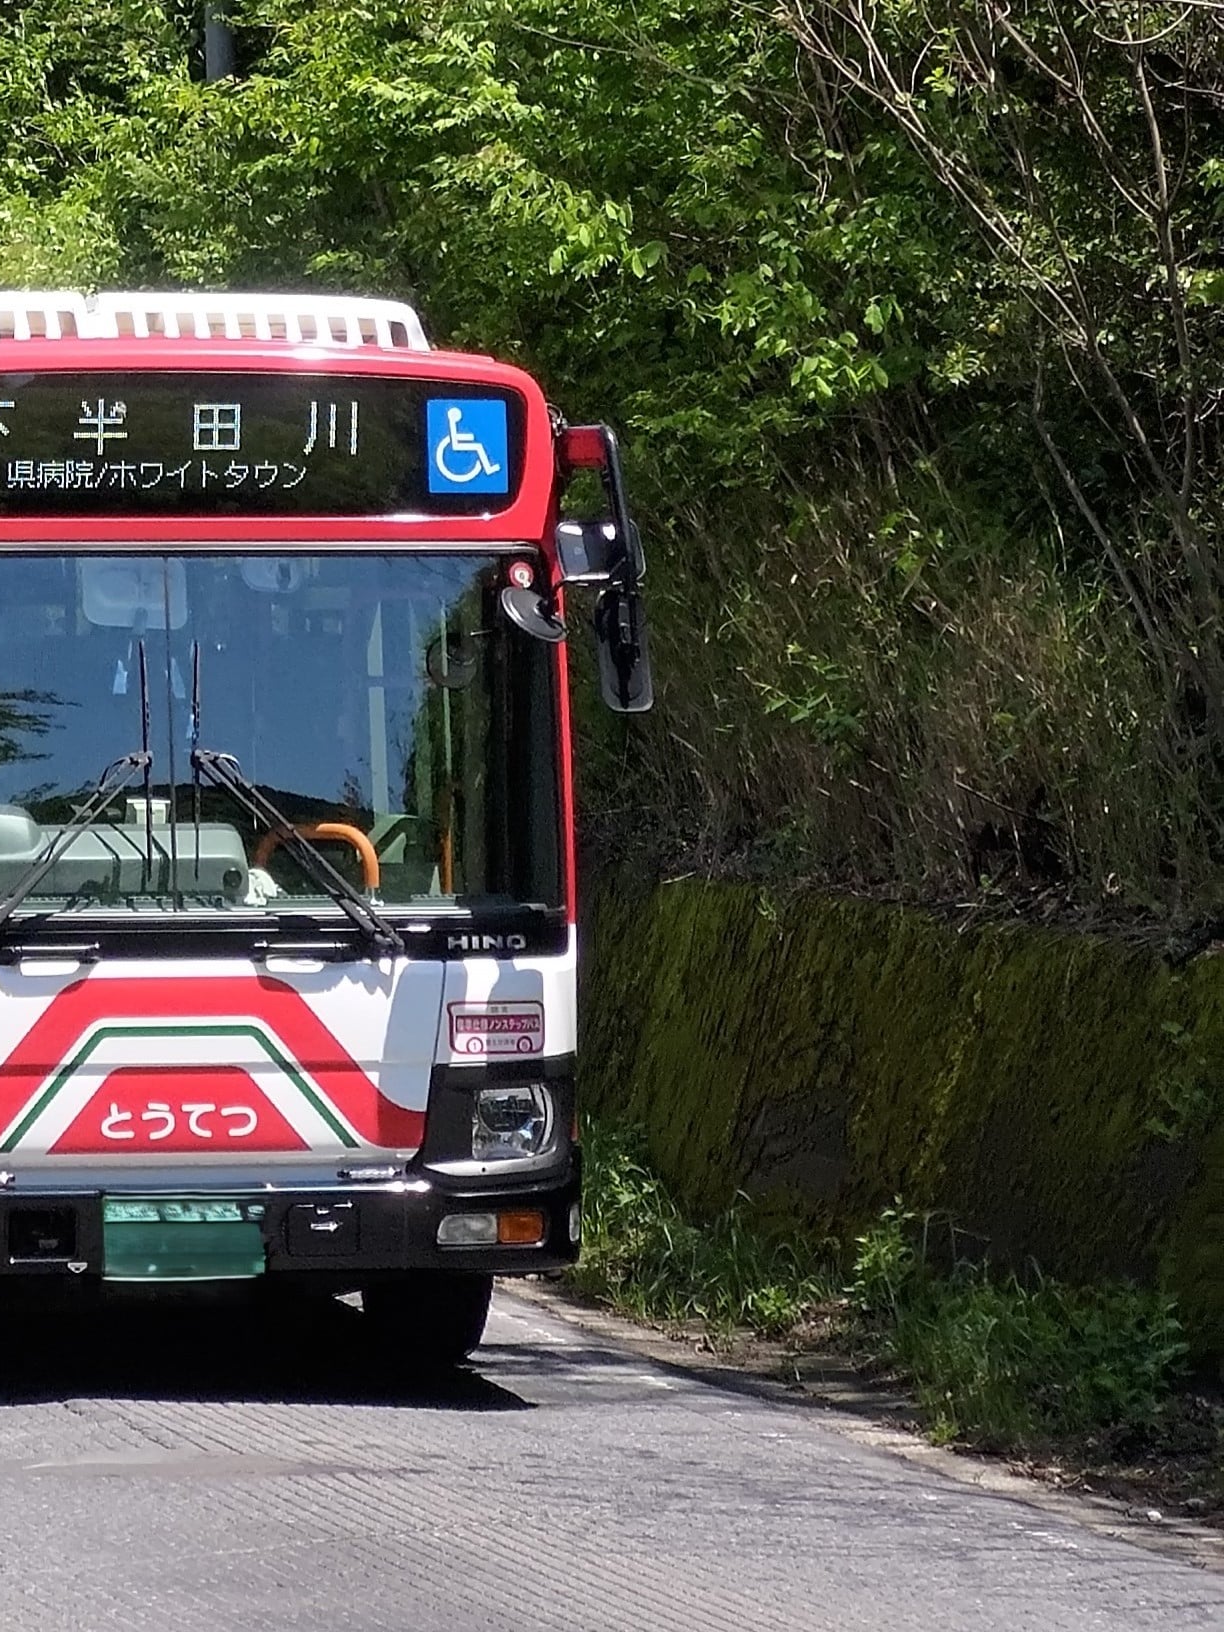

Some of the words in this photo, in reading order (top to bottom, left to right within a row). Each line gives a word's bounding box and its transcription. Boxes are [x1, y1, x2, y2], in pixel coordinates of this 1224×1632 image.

[6, 459, 307, 489] 県病院/ホワイトタウン
[447, 934, 526, 950] HINO
[100, 1102, 258, 1140] とうてつ
